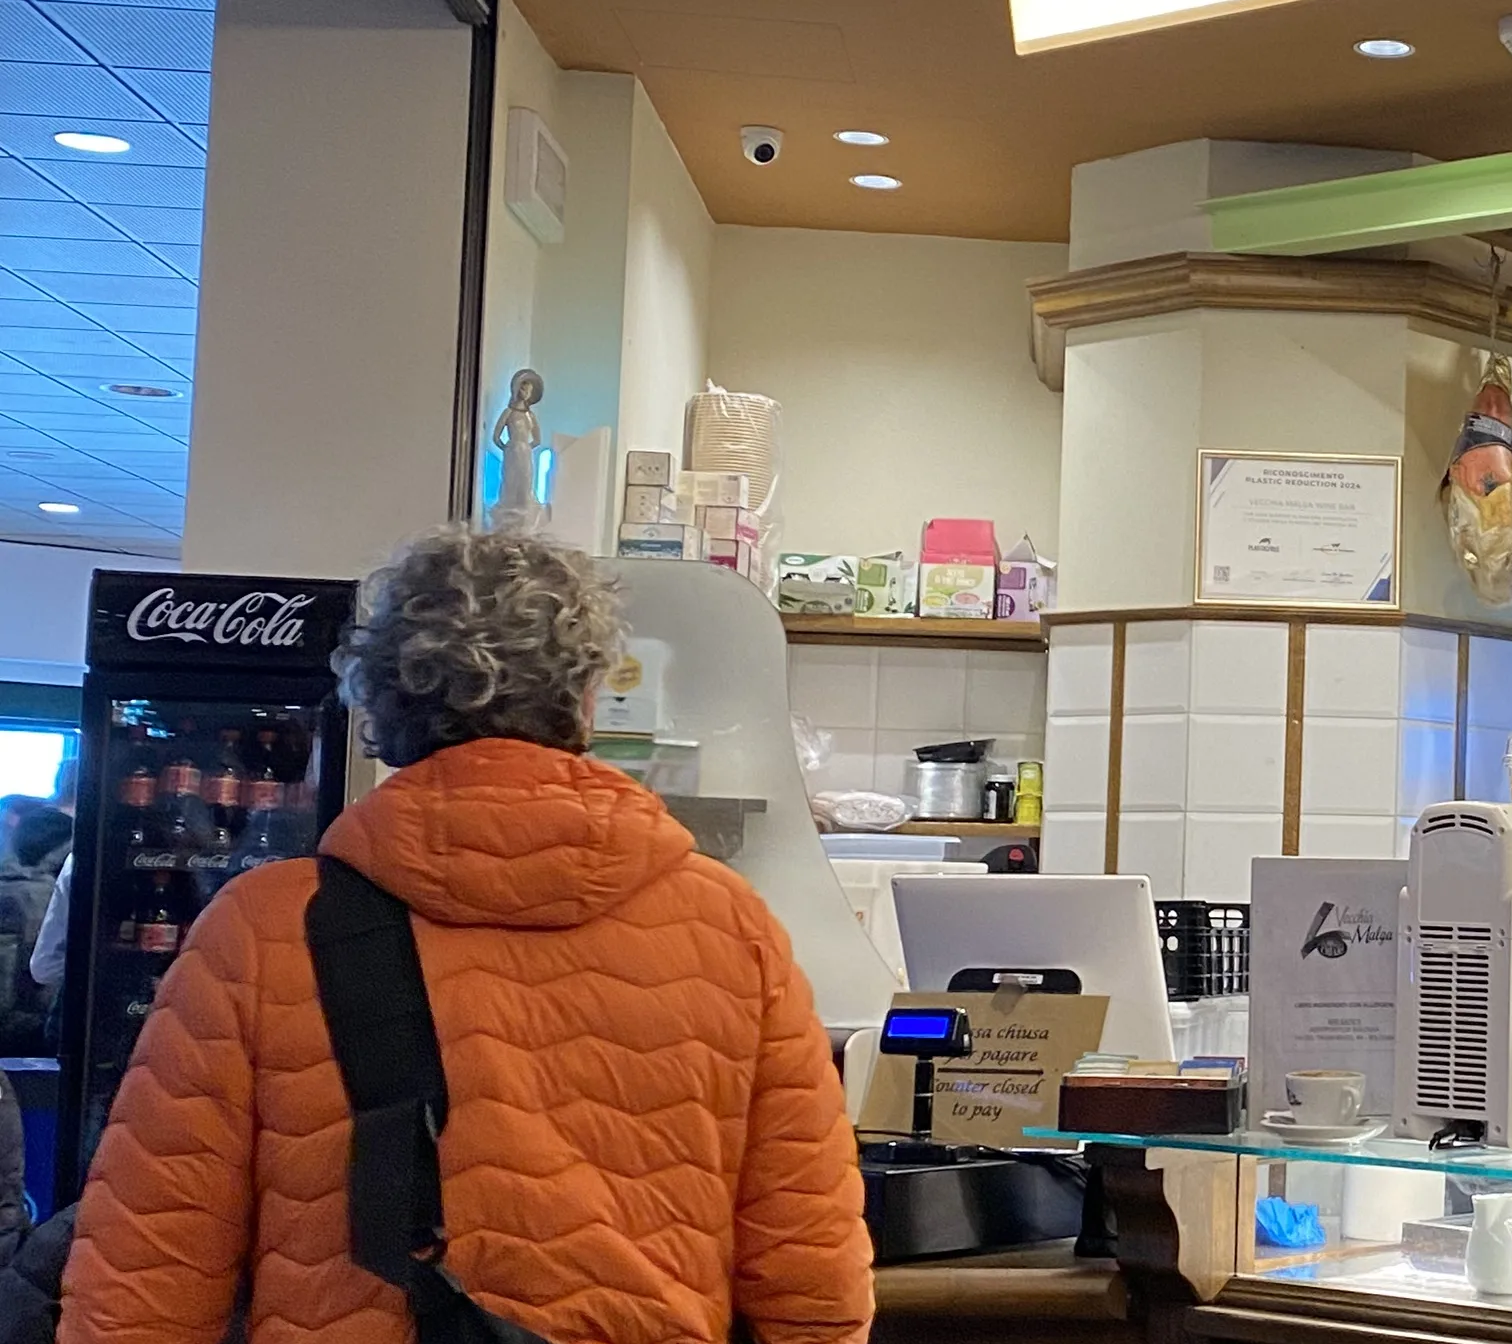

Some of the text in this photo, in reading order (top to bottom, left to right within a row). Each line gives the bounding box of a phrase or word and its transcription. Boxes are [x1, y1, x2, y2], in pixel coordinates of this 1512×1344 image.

[1245, 476, 1361, 490] PLASTIC REDUCTION 2024
[1263, 468, 1345, 480] RICONOSCIMENTO
[127, 587, 317, 646] Coca-Cola
[1350, 924, 1393, 946] Malga
[997, 1023, 1049, 1041] chiusa
[976, 1049, 1039, 1067] pagare
[992, 1077, 1047, 1096] closed
[952, 1101, 1003, 1121] to pay
